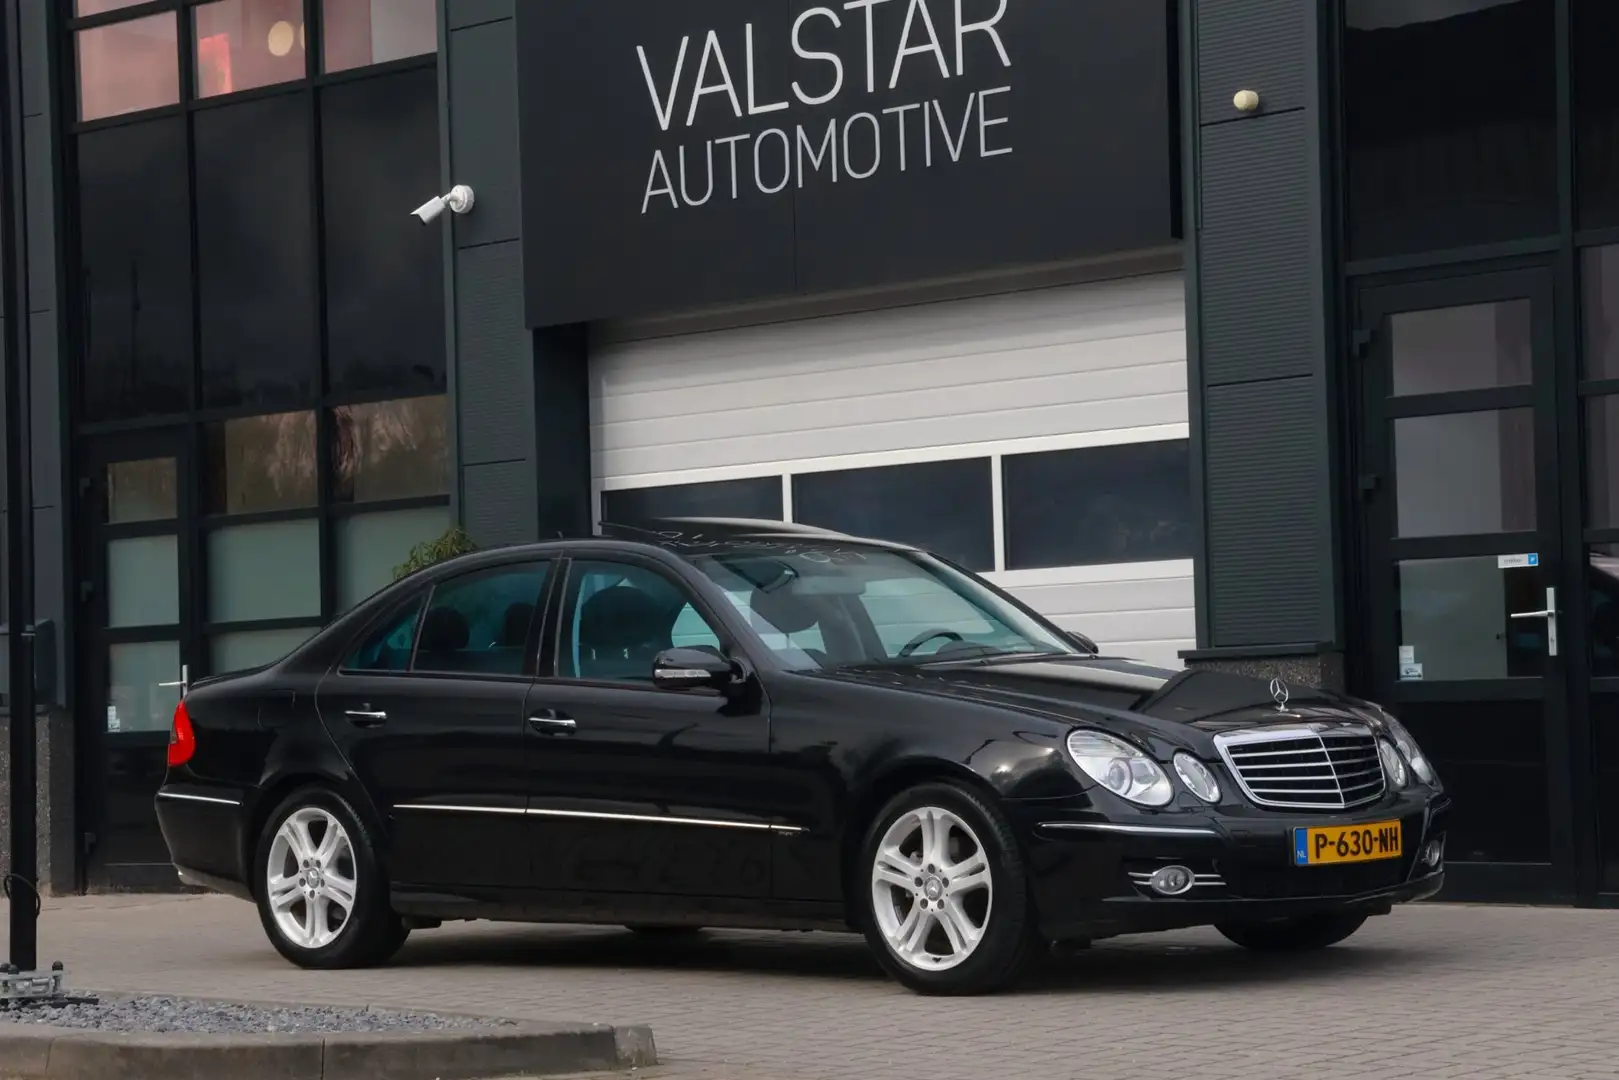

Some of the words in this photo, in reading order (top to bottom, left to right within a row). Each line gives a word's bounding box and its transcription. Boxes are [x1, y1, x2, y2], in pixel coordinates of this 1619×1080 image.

[635, 0, 1011, 130] VALSTAR
[641, 86, 1013, 214] AUTOMOTIVE
[1297, 850, 1307, 858] NL
[1314, 826, 1399, 860] P-630-NH
